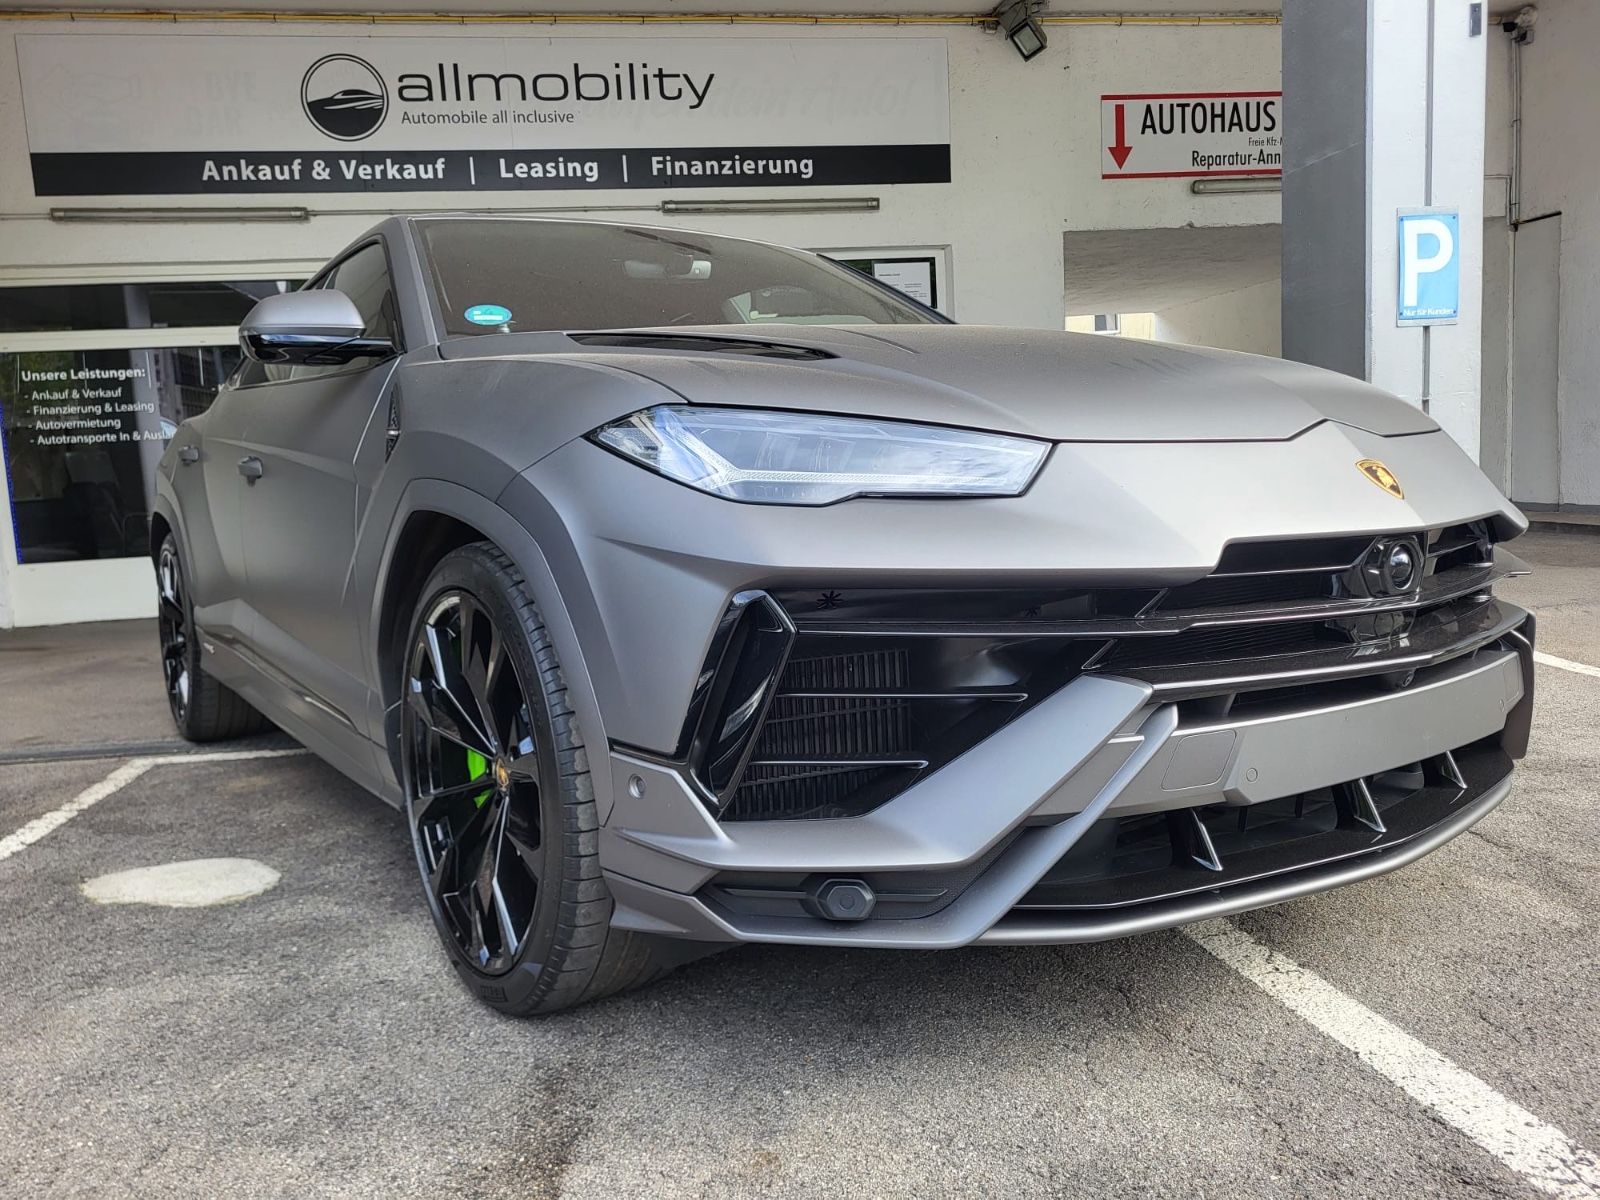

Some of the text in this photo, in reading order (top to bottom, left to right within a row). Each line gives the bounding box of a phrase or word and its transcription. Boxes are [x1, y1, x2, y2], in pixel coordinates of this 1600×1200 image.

[397, 63, 715, 109] allmobility
[401, 110, 575, 124] Automobile all inclusive
[1140, 101, 1276, 135] AUTOHAUS
[1248, 136, 1264, 147] Freie
[202, 158, 302, 181] Ankauf
[311, 159, 331, 180] &
[338, 157, 446, 181] Verkauf
[499, 157, 599, 183] Leasing
[651, 154, 814, 179] Finanzierung
[1403, 219, 1454, 307] P
[21, 367, 146, 382] Unsere Leistungen:
[31, 387, 123, 401] Ankauf & Verkauf
[33, 401, 155, 416] Finanzierung & Leasing
[35, 418, 121, 431] Autovermietung
[37, 431, 117, 446] Autotransporte
[120, 431, 130, 442] In
[132, 430, 141, 441] &
